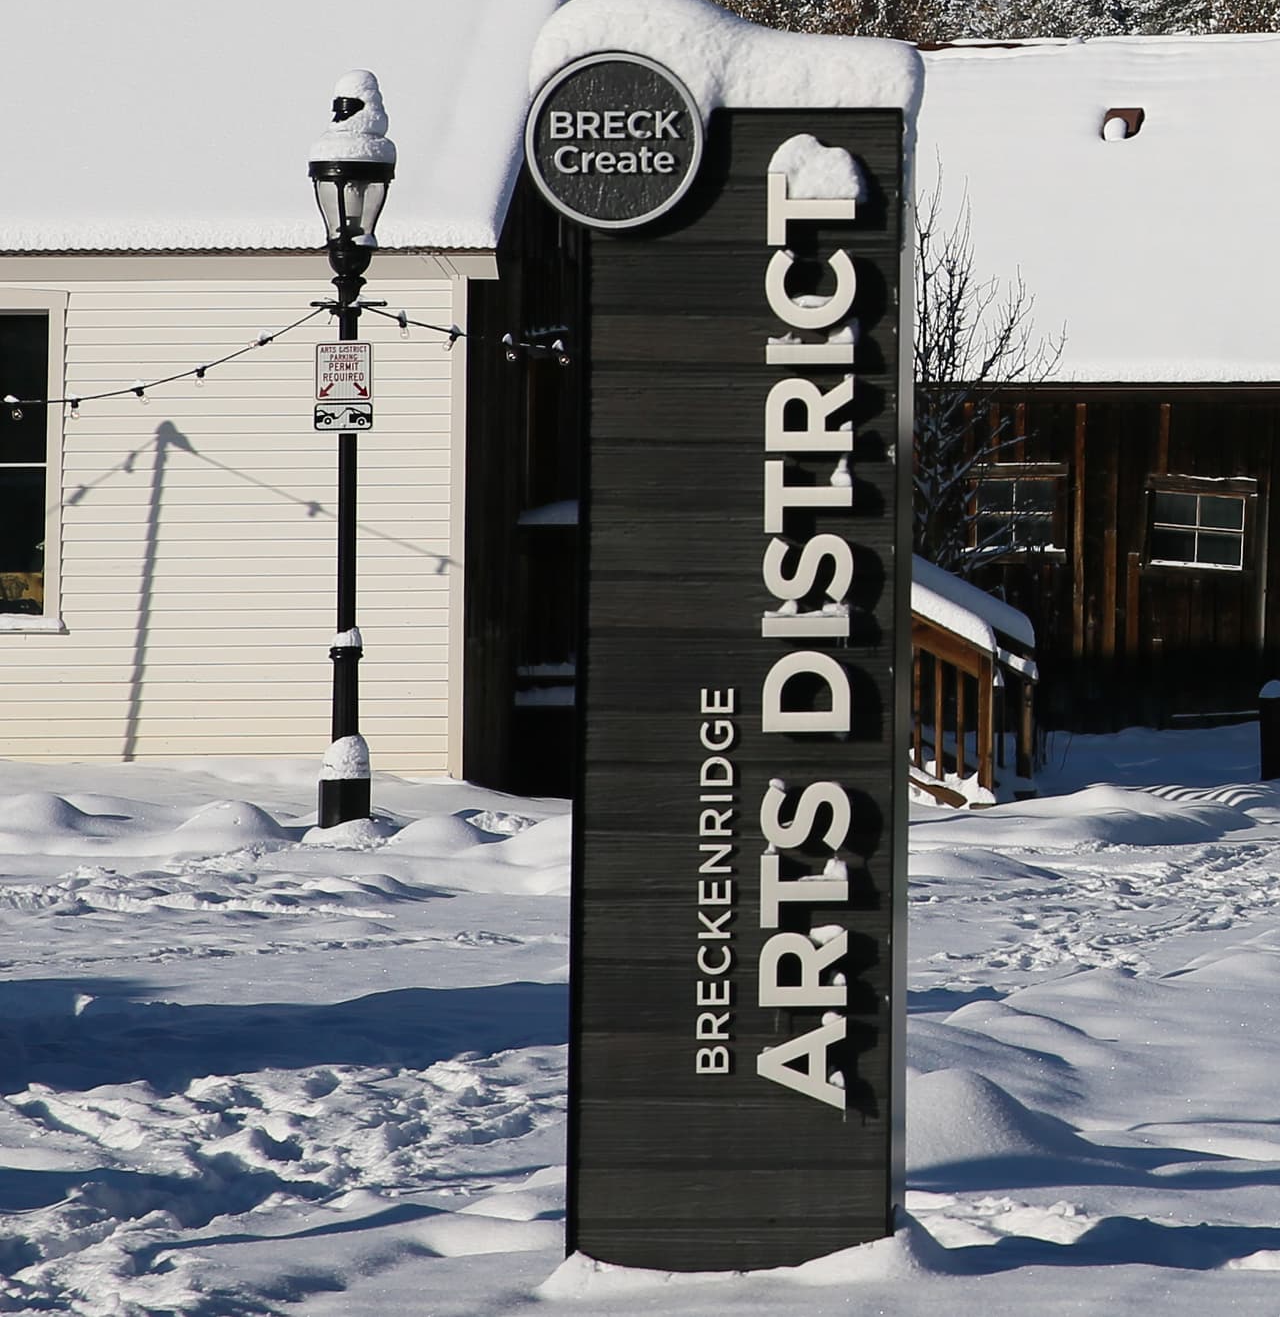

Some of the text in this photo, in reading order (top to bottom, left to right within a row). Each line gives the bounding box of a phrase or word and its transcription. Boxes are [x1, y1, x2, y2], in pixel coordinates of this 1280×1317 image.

[550, 110, 681, 139] BRECK
[553, 145, 675, 174] Create
[330, 353, 358, 361] PARKING
[339, 345, 367, 353] DISTRICT
[328, 362, 359, 371] PERMIT
[322, 372, 365, 382] REQUIRED
[757, 172, 857, 1110] ARTS DISTRICT
[696, 687, 735, 1075] BRECKENRIDGE
